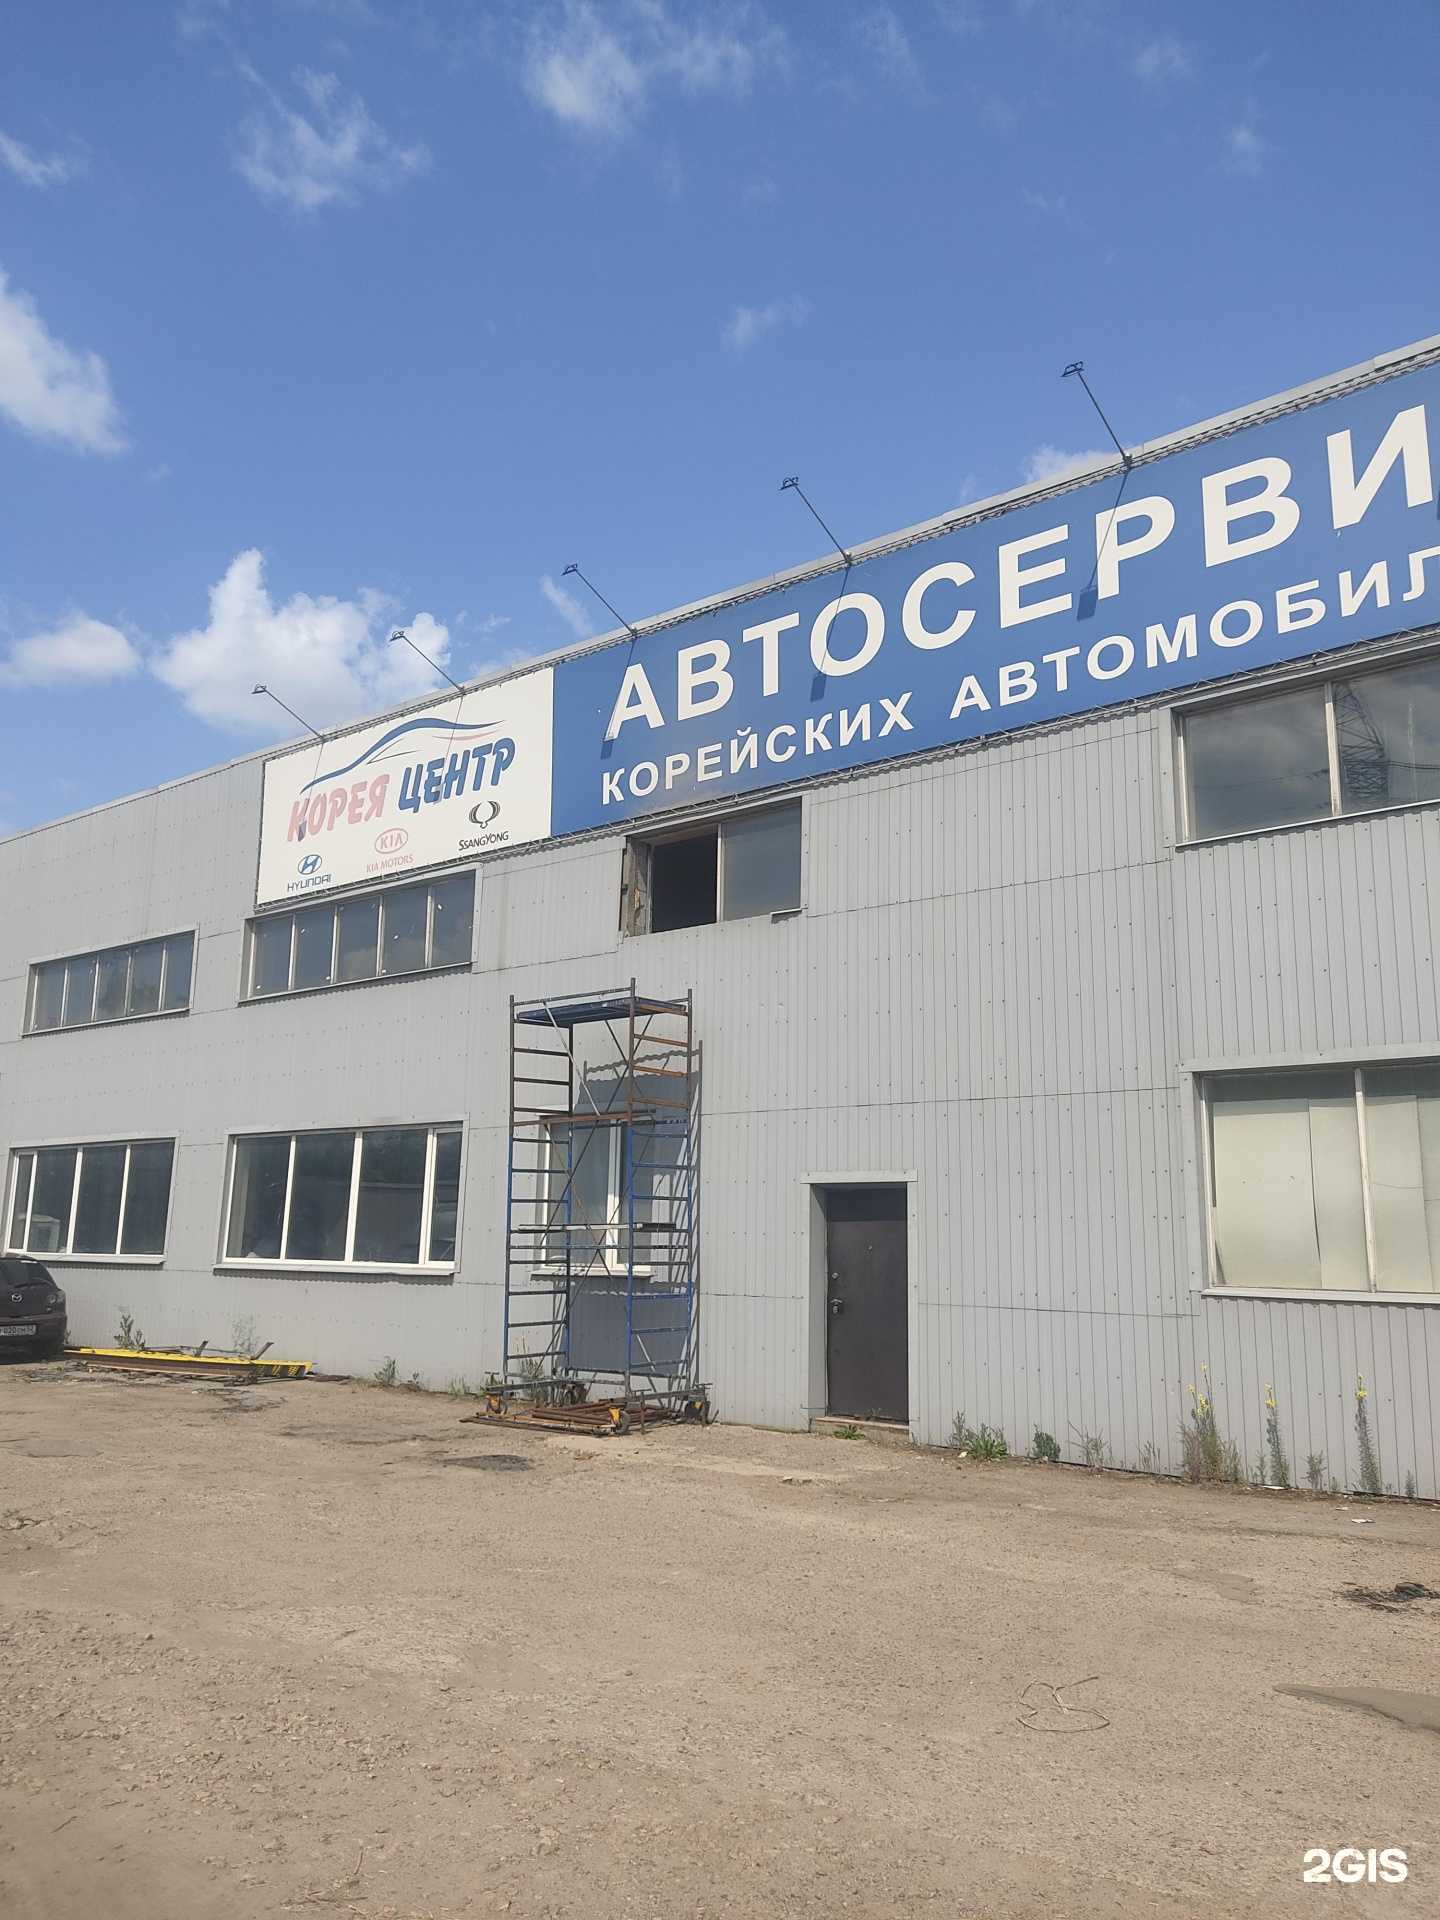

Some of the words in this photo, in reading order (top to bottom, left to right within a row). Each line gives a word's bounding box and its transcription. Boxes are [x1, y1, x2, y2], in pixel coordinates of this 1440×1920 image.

[604, 404, 1433, 741] АВТОСЕРВИ
[602, 692, 914, 805] КОРЕЙСКИХ
[287, 774, 390, 842] КОРЕЯ
[398, 737, 516, 813] ЦЕНТР
[366, 862, 379, 873] KIA
[380, 855, 414, 870] MOTORS
[380, 832, 403, 849] KIA
[287, 873, 331, 892] HYUNDAI
